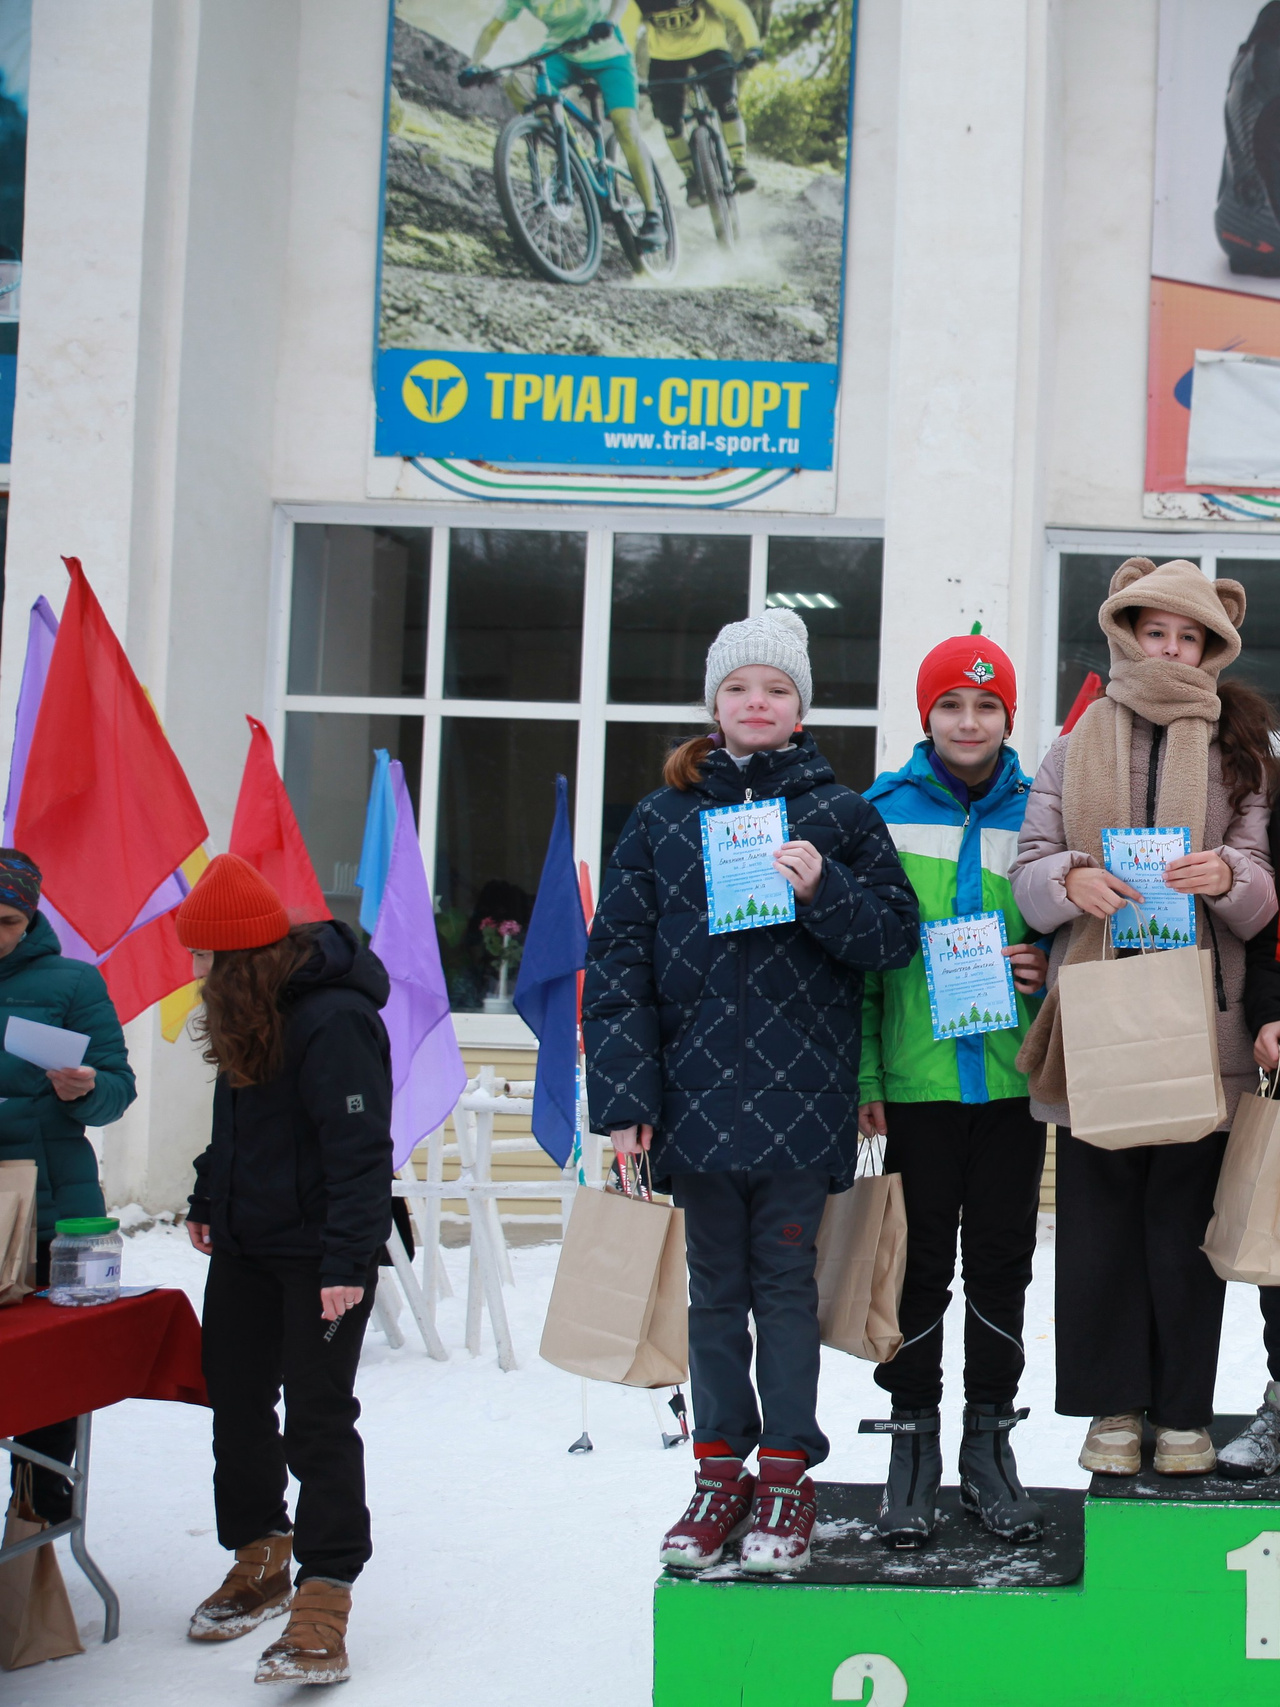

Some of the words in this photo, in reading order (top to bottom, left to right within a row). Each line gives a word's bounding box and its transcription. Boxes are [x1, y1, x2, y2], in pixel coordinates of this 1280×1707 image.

[604, 431, 800, 455] www.trial-sport.ru
[718, 834, 773, 851] ГРАМОТА
[1120, 861, 1167, 872] ГРАМОТ
[939, 946, 993, 961] ГРАМОТА
[874, 1423, 916, 1431] SPINE
[769, 1486, 801, 1497] TOREAD
